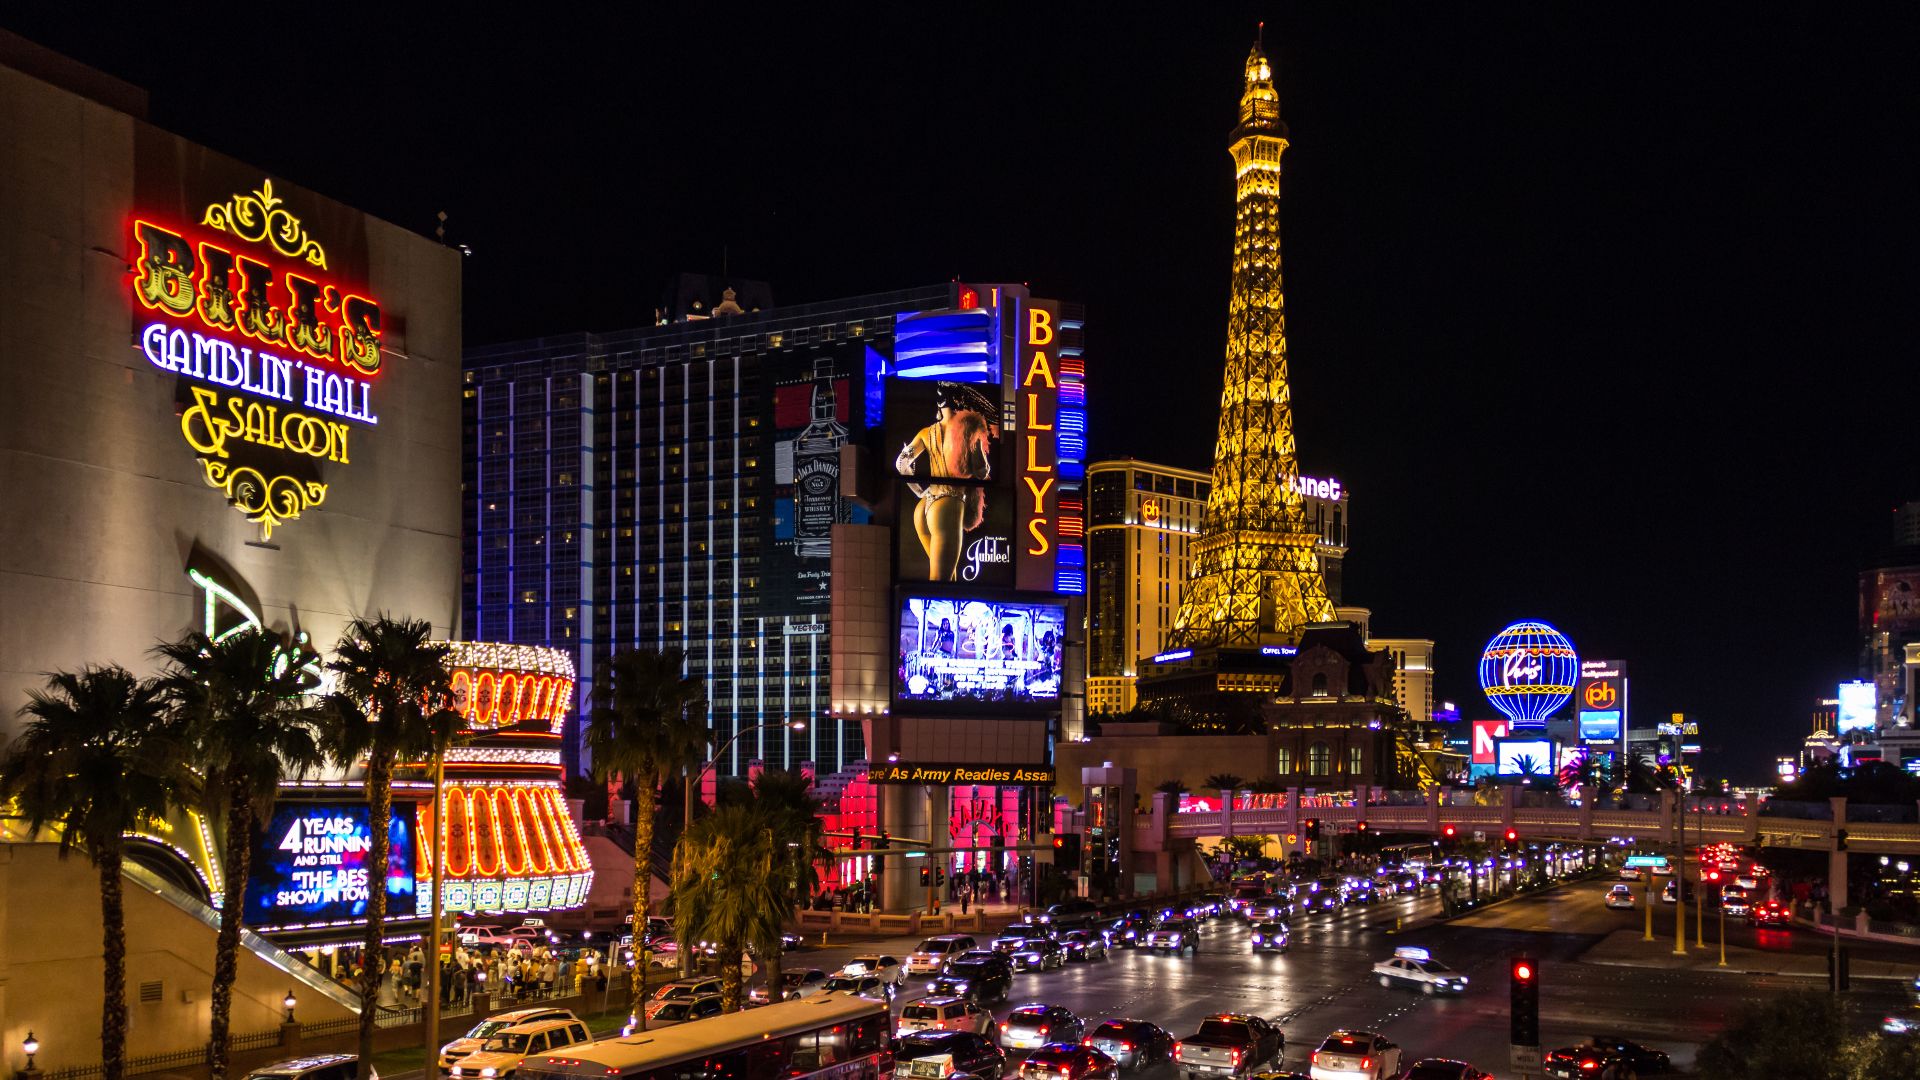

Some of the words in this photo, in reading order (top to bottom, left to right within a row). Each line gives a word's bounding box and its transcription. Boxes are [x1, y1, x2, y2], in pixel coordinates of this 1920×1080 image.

[134, 219, 384, 375] BILL'S
[304, 365, 378, 424] HALL
[224, 396, 350, 464] SALOON
[962, 537, 1010, 581] Jubilee!
[792, 624, 824, 632] VECTOR
[889, 767, 908, 780] As
[912, 767, 951, 783] Army
[954, 768, 1011, 781] Readies
[278, 817, 303, 854] 4
[302, 817, 354, 835] YEARS
[303, 835, 371, 854] RUNNIN
[293, 855, 318, 867] AND
[319, 854, 343, 865] STILL
[336, 868, 369, 889] BES
[276, 889, 320, 906] SHOW
[323, 889, 340, 903] IN
[341, 886, 370, 901] TOW
